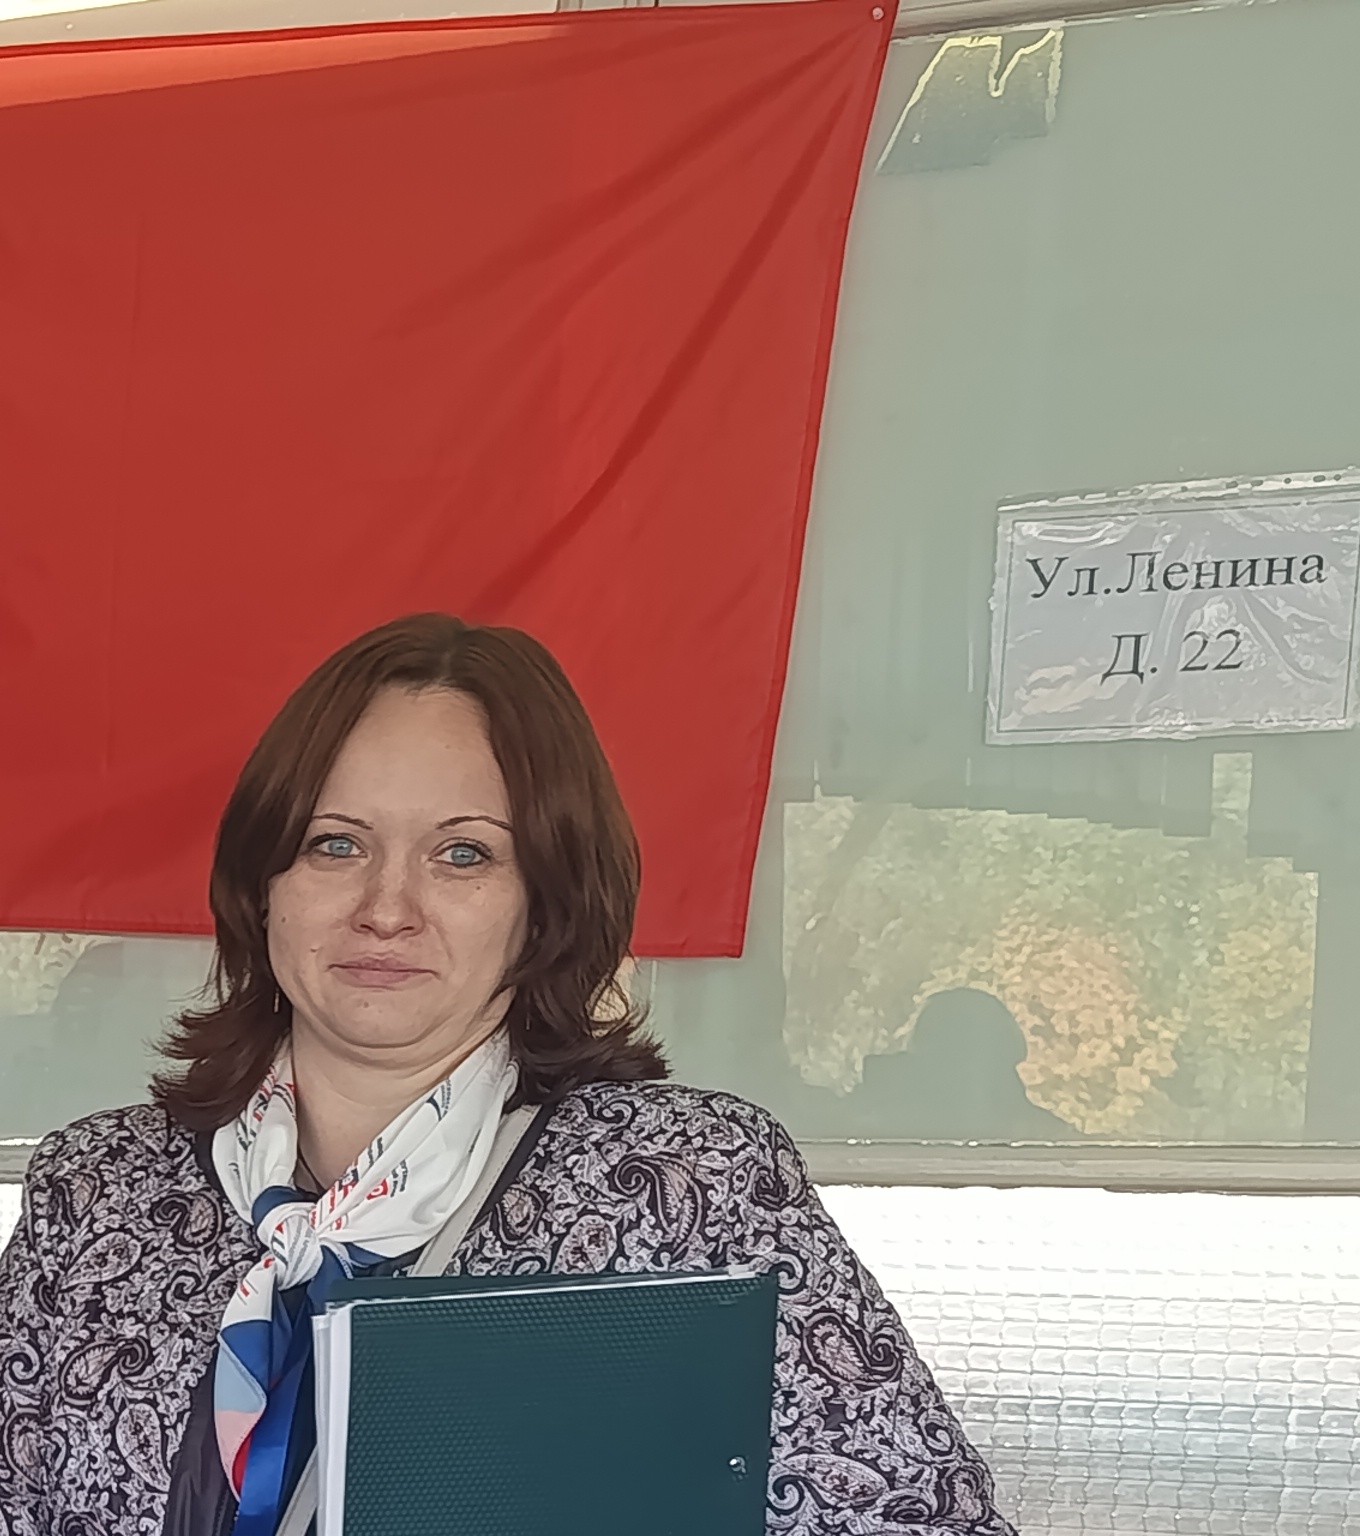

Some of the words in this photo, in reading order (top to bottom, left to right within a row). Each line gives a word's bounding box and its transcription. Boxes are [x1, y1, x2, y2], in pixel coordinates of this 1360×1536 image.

[1026, 551, 1327, 599] Ул.Ленина
[1100, 633, 1158, 685] Д.
[1180, 628, 1244, 671] 22
